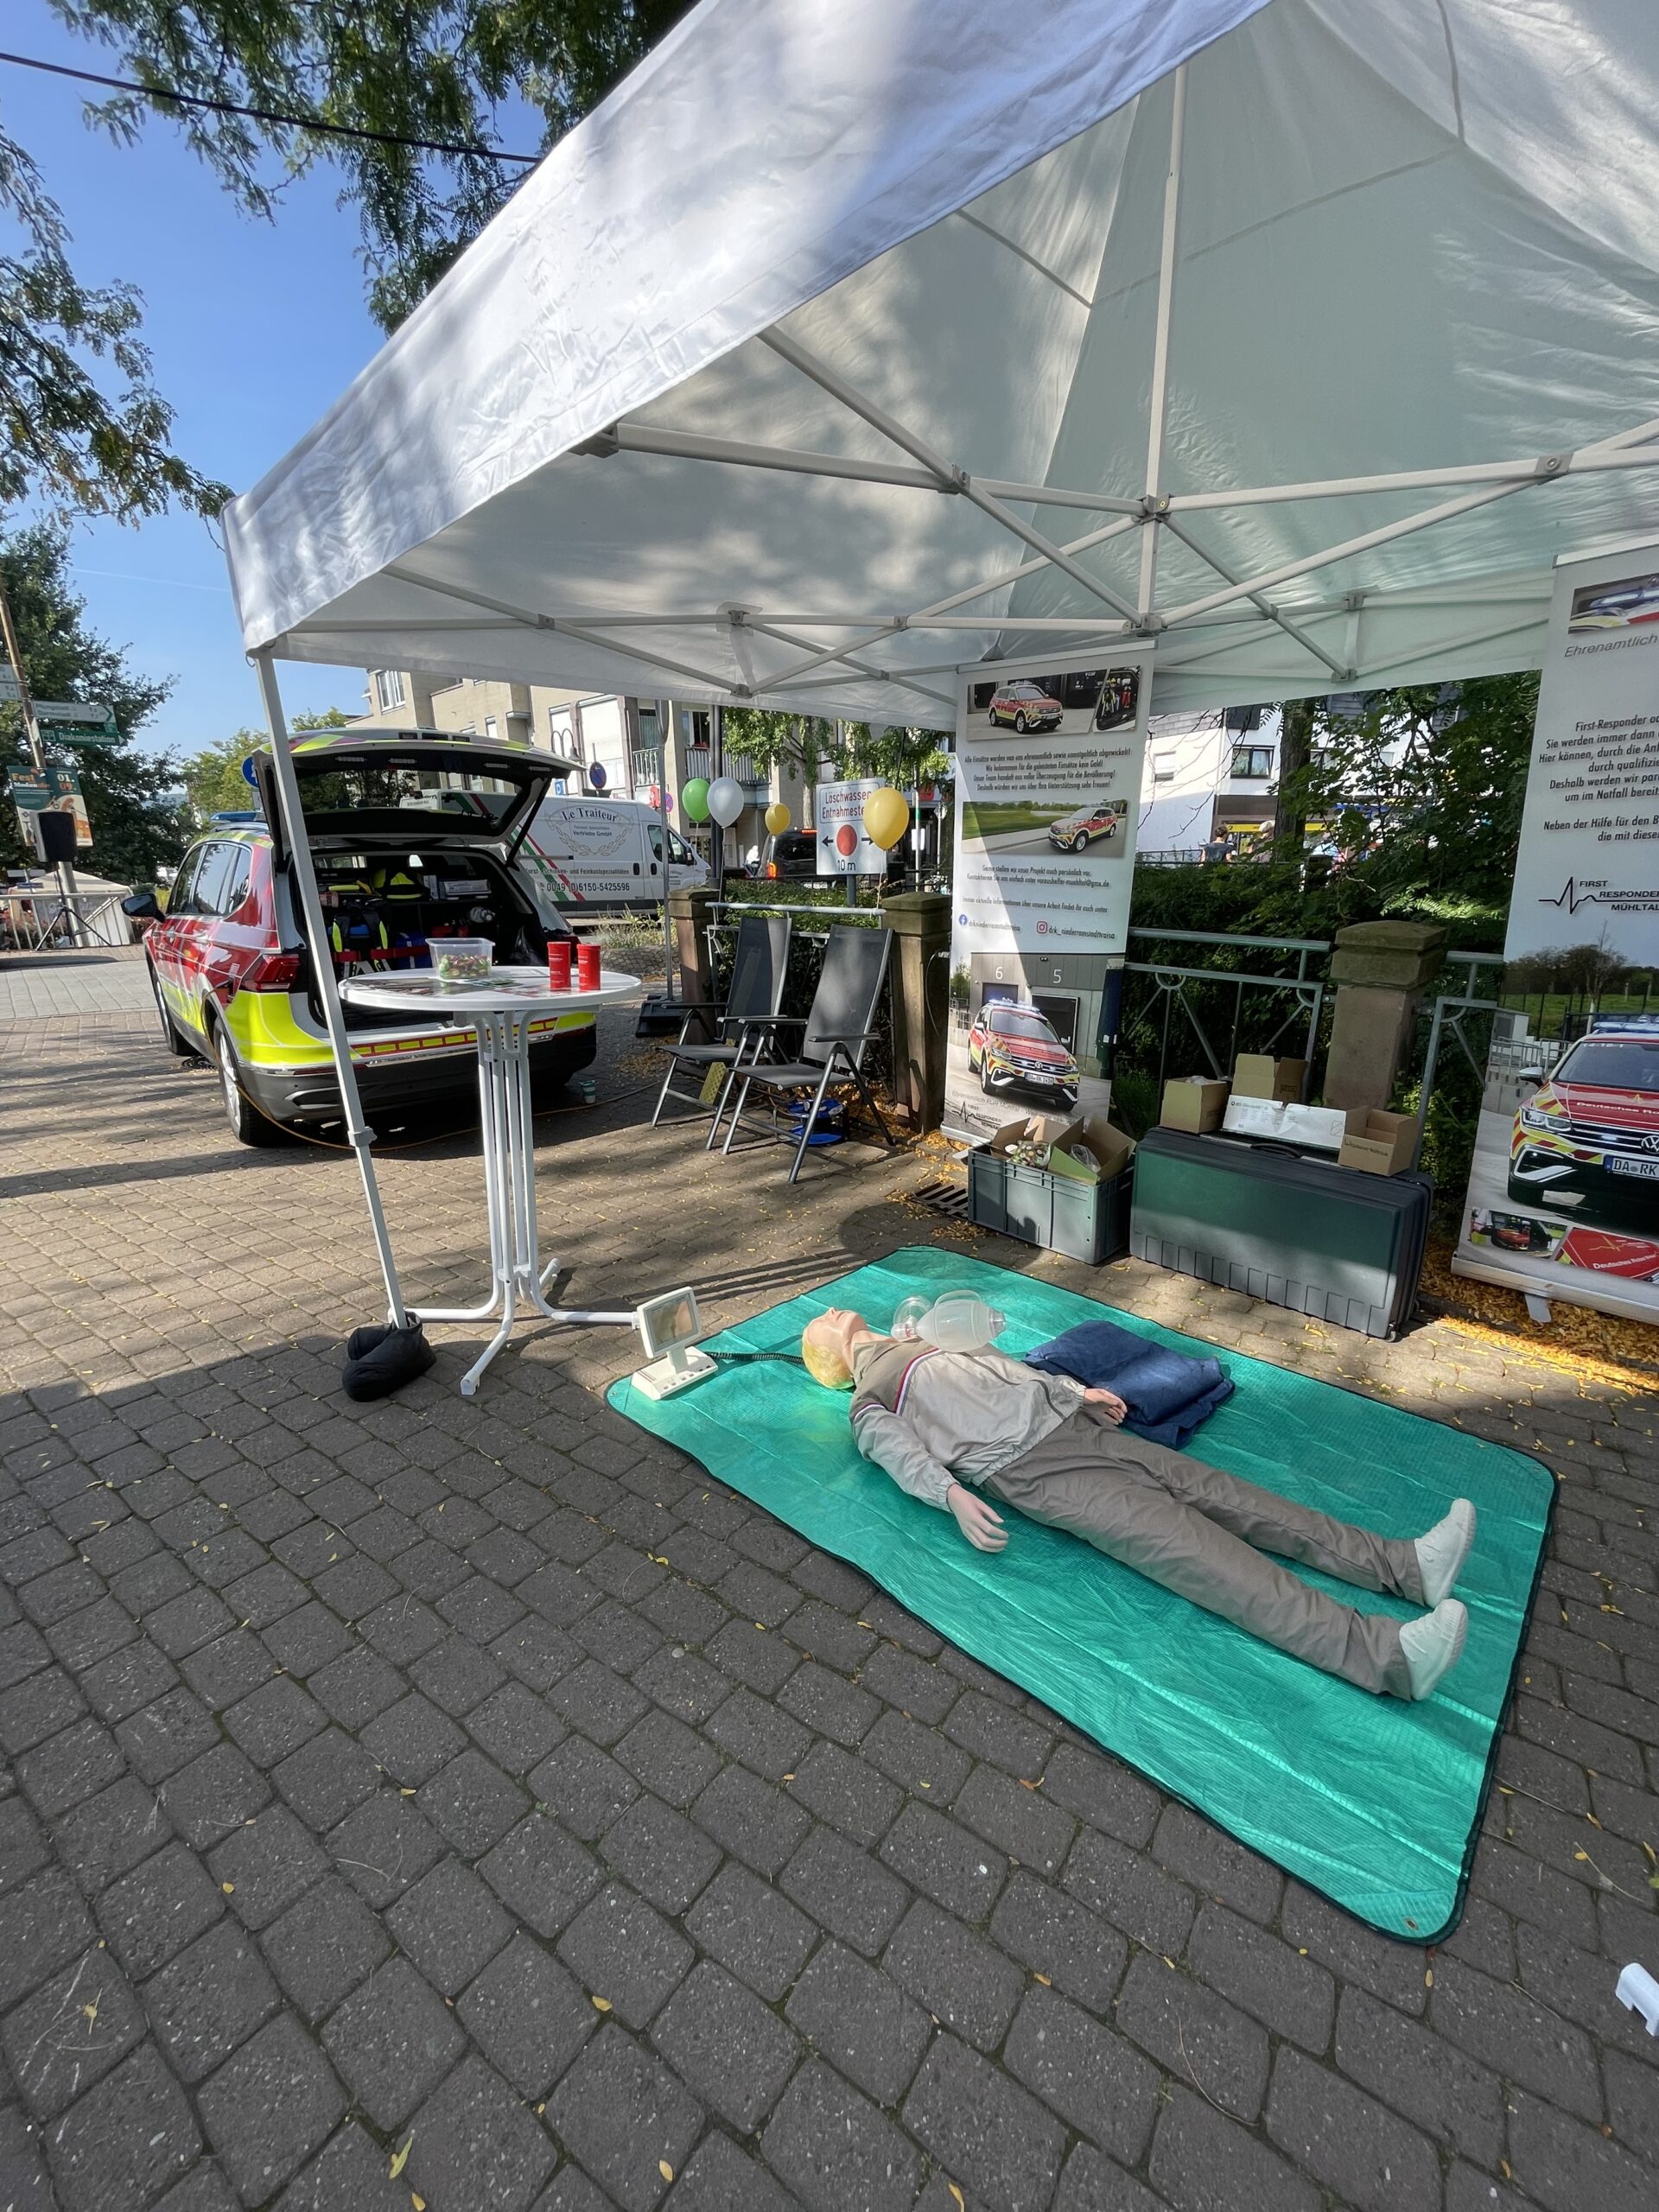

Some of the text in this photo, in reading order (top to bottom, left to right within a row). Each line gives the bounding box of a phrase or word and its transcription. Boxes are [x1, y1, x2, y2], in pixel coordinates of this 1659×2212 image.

[1564, 633, 1659, 658] Ehrenamtlich
[1574, 714, 1648, 733] First-Responder
[1546, 728, 1655, 749] Sie werden immer dann
[1539, 753, 1556, 763] Hier
[1558, 750, 1594, 761] können,
[1597, 745, 1624, 758] durch
[1626, 743, 1641, 755] die
[1588, 760, 1614, 772] durch
[1549, 777, 1585, 790] Deshalb
[1587, 774, 1621, 786] werden
[1624, 773, 1639, 783] wir
[1581, 791, 1593, 800] im
[1596, 787, 1629, 799] Notfall
[562, 807, 617, 823] Le Traiteur
[822, 805, 865, 819] Entnahmeste
[1543, 819, 1571, 830] Neben
[1573, 818, 1589, 830] der
[1591, 817, 1612, 828] Hilfe
[1615, 815, 1630, 827] für
[1631, 815, 1649, 826] den
[1598, 830, 1612, 842] die
[1614, 830, 1630, 841] mit
[837, 860, 856, 872] 10 m
[546, 882, 566, 892] 0049
[1611, 902, 1659, 911] MÜHLTAL
[995, 965, 1003, 980] 6
[1052, 969, 1062, 984] 5
[1576, 1102, 1640, 1113] Deutsches
[1613, 1159, 1659, 1176] DA RK
[1592, 1260, 1632, 1269] Deutsches
